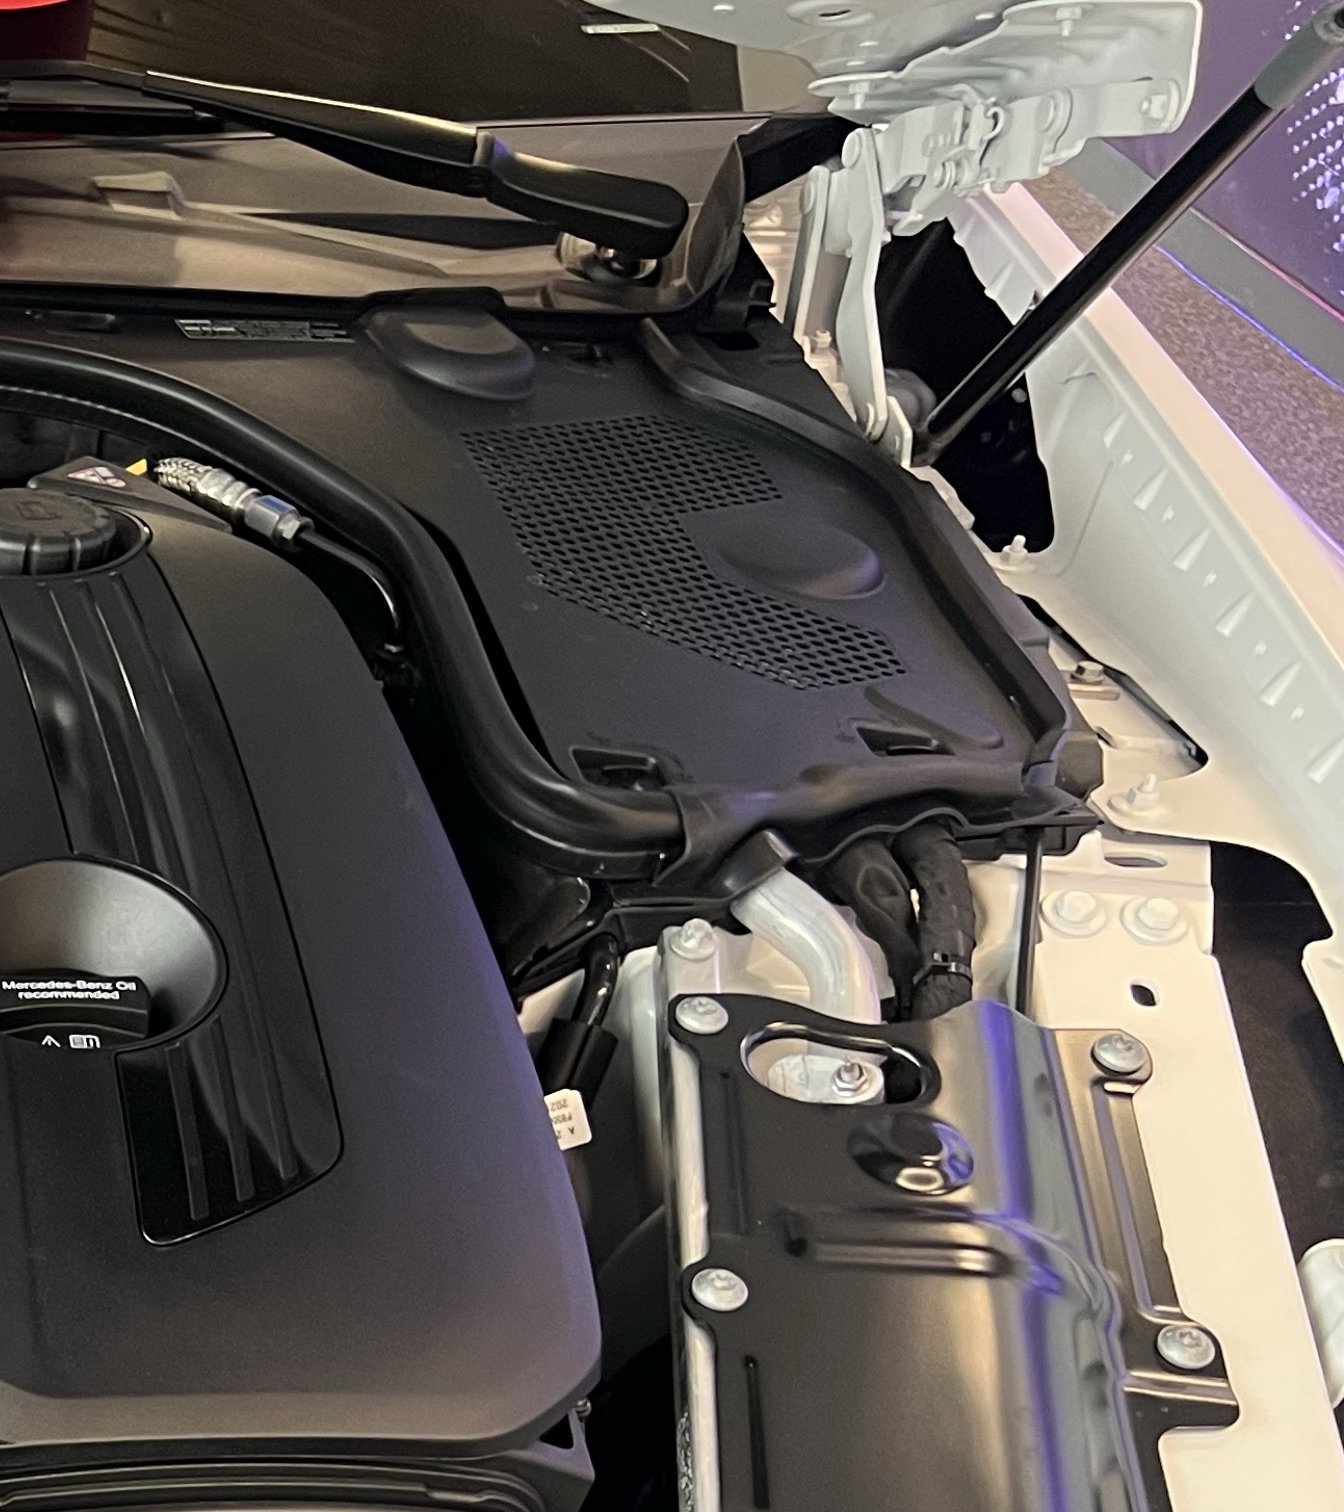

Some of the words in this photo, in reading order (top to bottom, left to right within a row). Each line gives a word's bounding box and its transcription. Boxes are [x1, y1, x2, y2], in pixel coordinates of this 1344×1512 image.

[2, 980, 112, 990] Mercedes-Benz
[115, 980, 137, 991] Oil
[17, 990, 120, 1000] recommended
